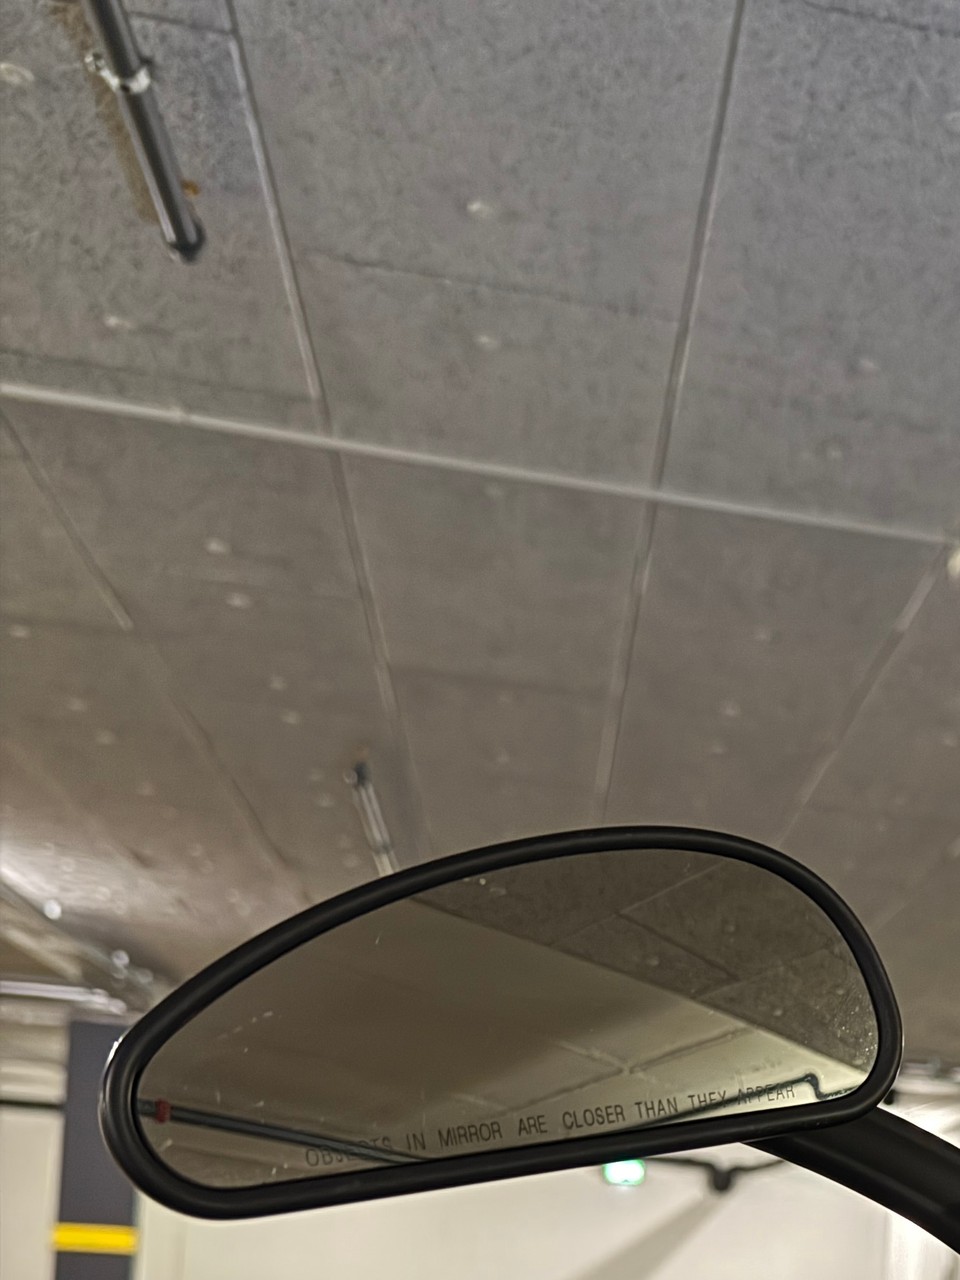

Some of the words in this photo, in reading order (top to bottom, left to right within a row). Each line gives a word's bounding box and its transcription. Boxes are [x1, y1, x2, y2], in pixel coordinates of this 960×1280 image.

[406, 1133, 427, 1152] IN
[438, 1121, 503, 1149] MIRROR
[517, 1114, 548, 1136] ARE
[561, 1104, 626, 1130] CLOSER
[634, 1096, 679, 1119] THAN
[687, 1090, 727, 1111] THEY
[737, 1083, 796, 1107] APPEAR
